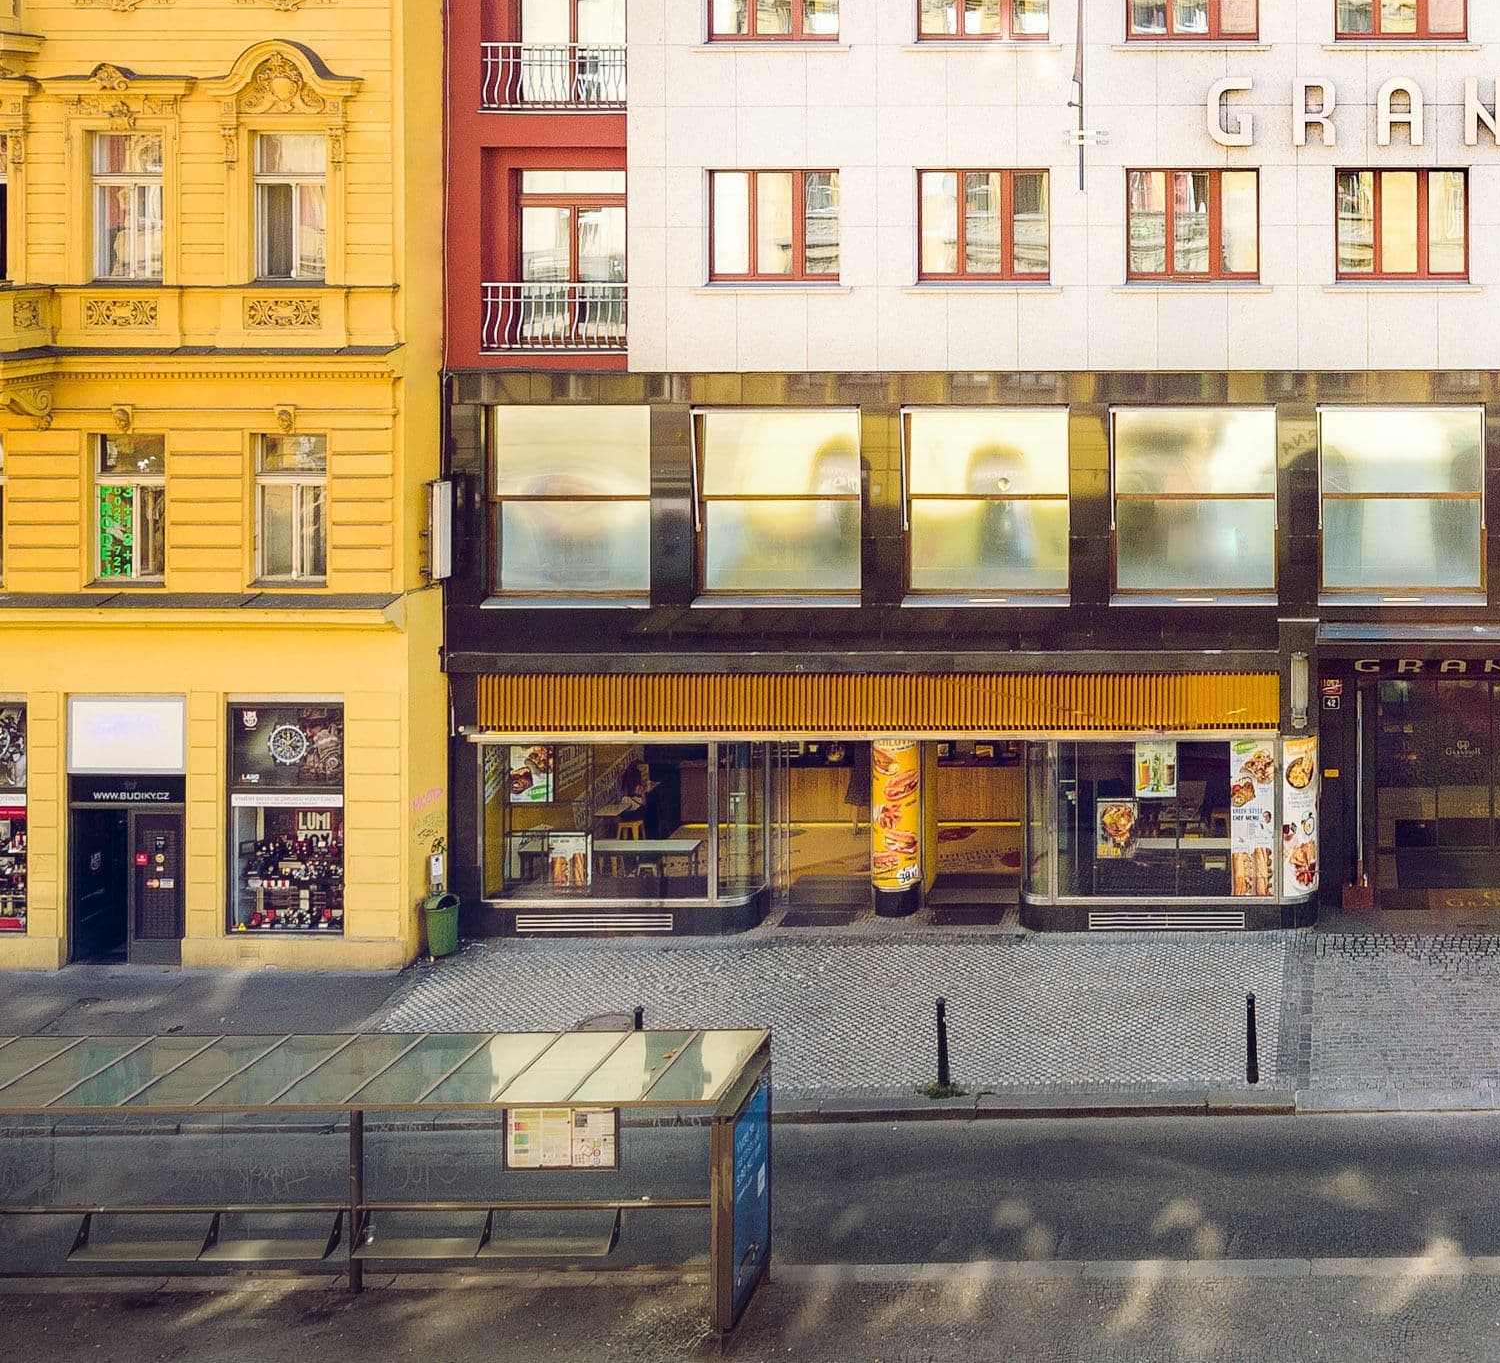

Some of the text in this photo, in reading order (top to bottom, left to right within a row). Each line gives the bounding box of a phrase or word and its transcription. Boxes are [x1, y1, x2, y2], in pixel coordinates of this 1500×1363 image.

[1327, 699, 1336, 707] 42
[93, 792, 170, 800] WWW.BUDIKY.CZ
[298, 811, 331, 830] LUMI
